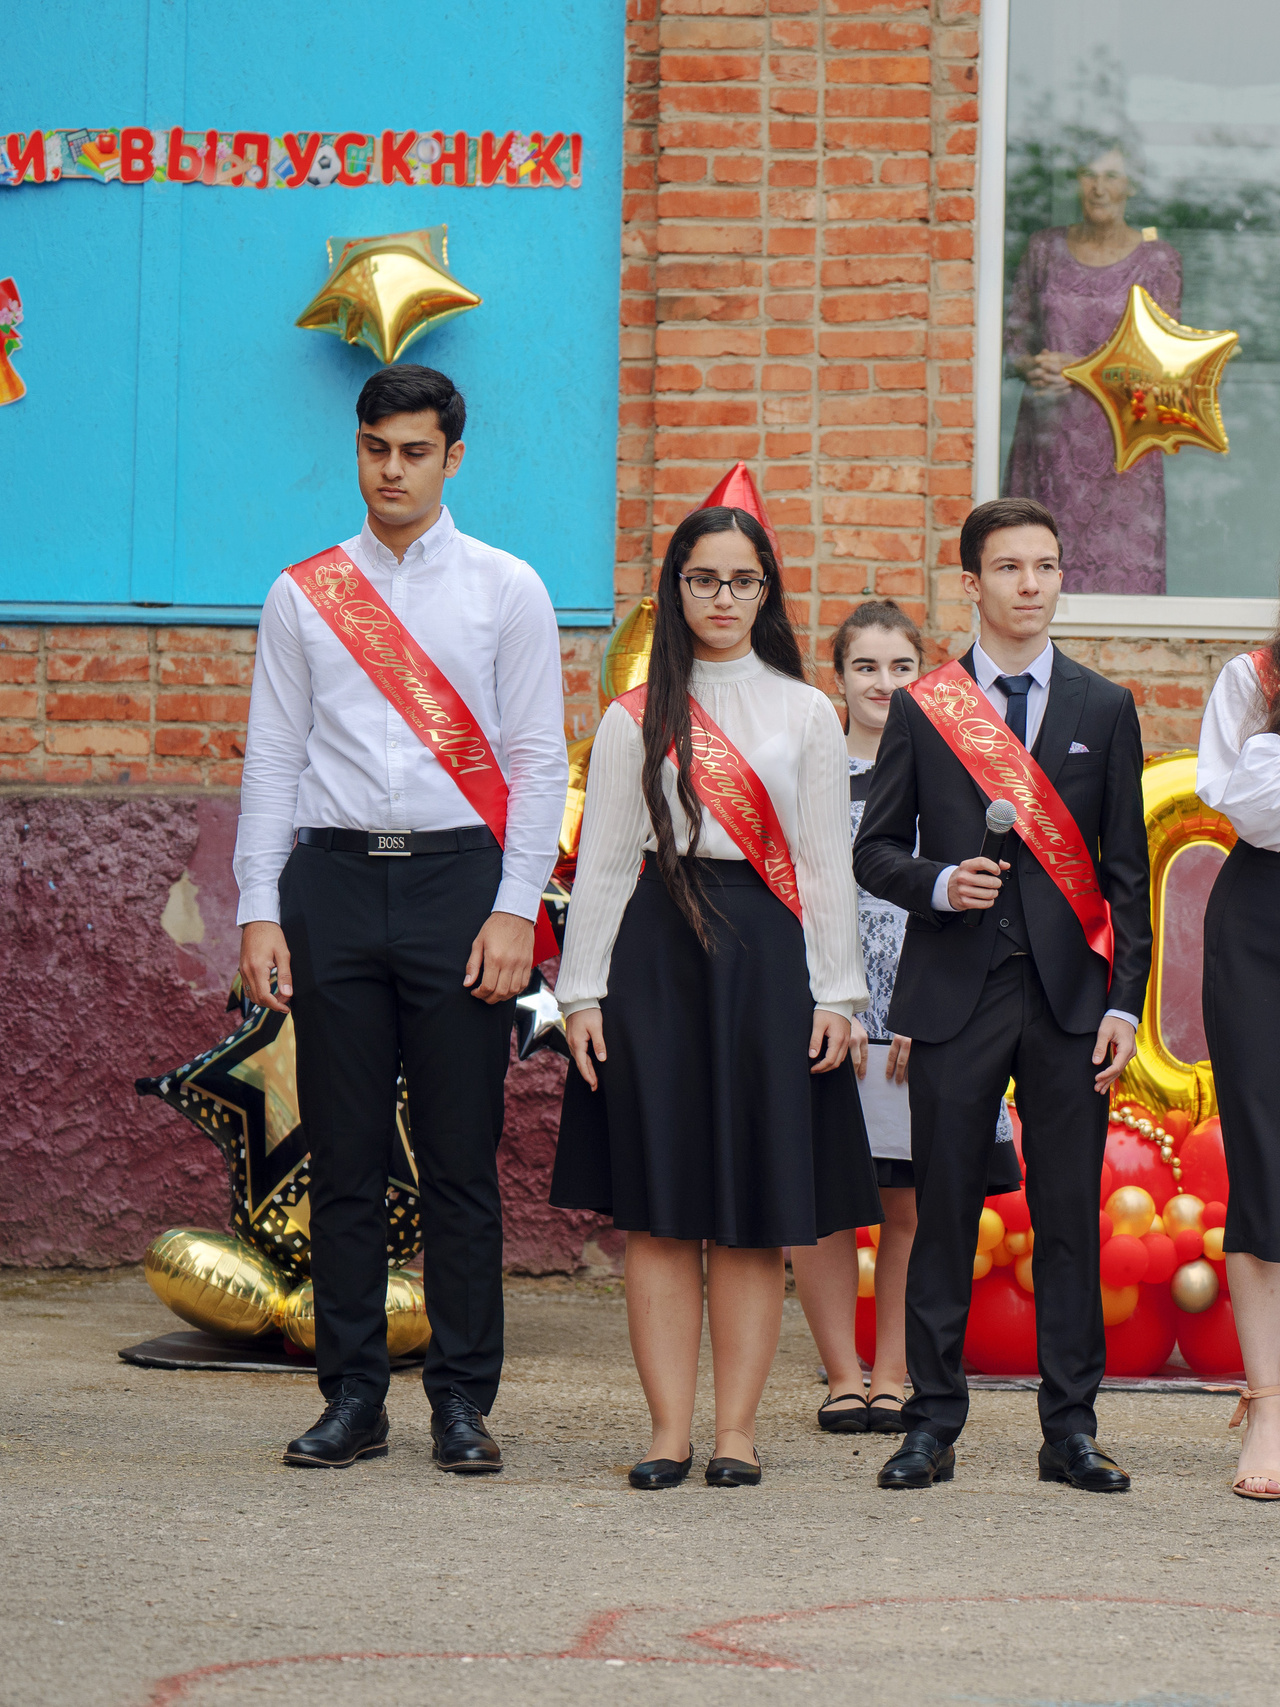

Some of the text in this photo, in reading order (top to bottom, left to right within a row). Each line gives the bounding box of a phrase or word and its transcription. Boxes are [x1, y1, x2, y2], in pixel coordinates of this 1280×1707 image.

[118, 126, 583, 189] ВЫПУСКНИК!
[339, 599, 493, 776] Выпускник 2021
[373, 669, 425, 729] Республика Адыгея
[690, 726, 777, 853] Выпускник
[957, 717, 1099, 898] Выпускник 2021
[377, 836, 405, 849] BOSS
[710, 797, 761, 859] Республика Адыгея
[1021, 826, 1044, 850] Адыгея
